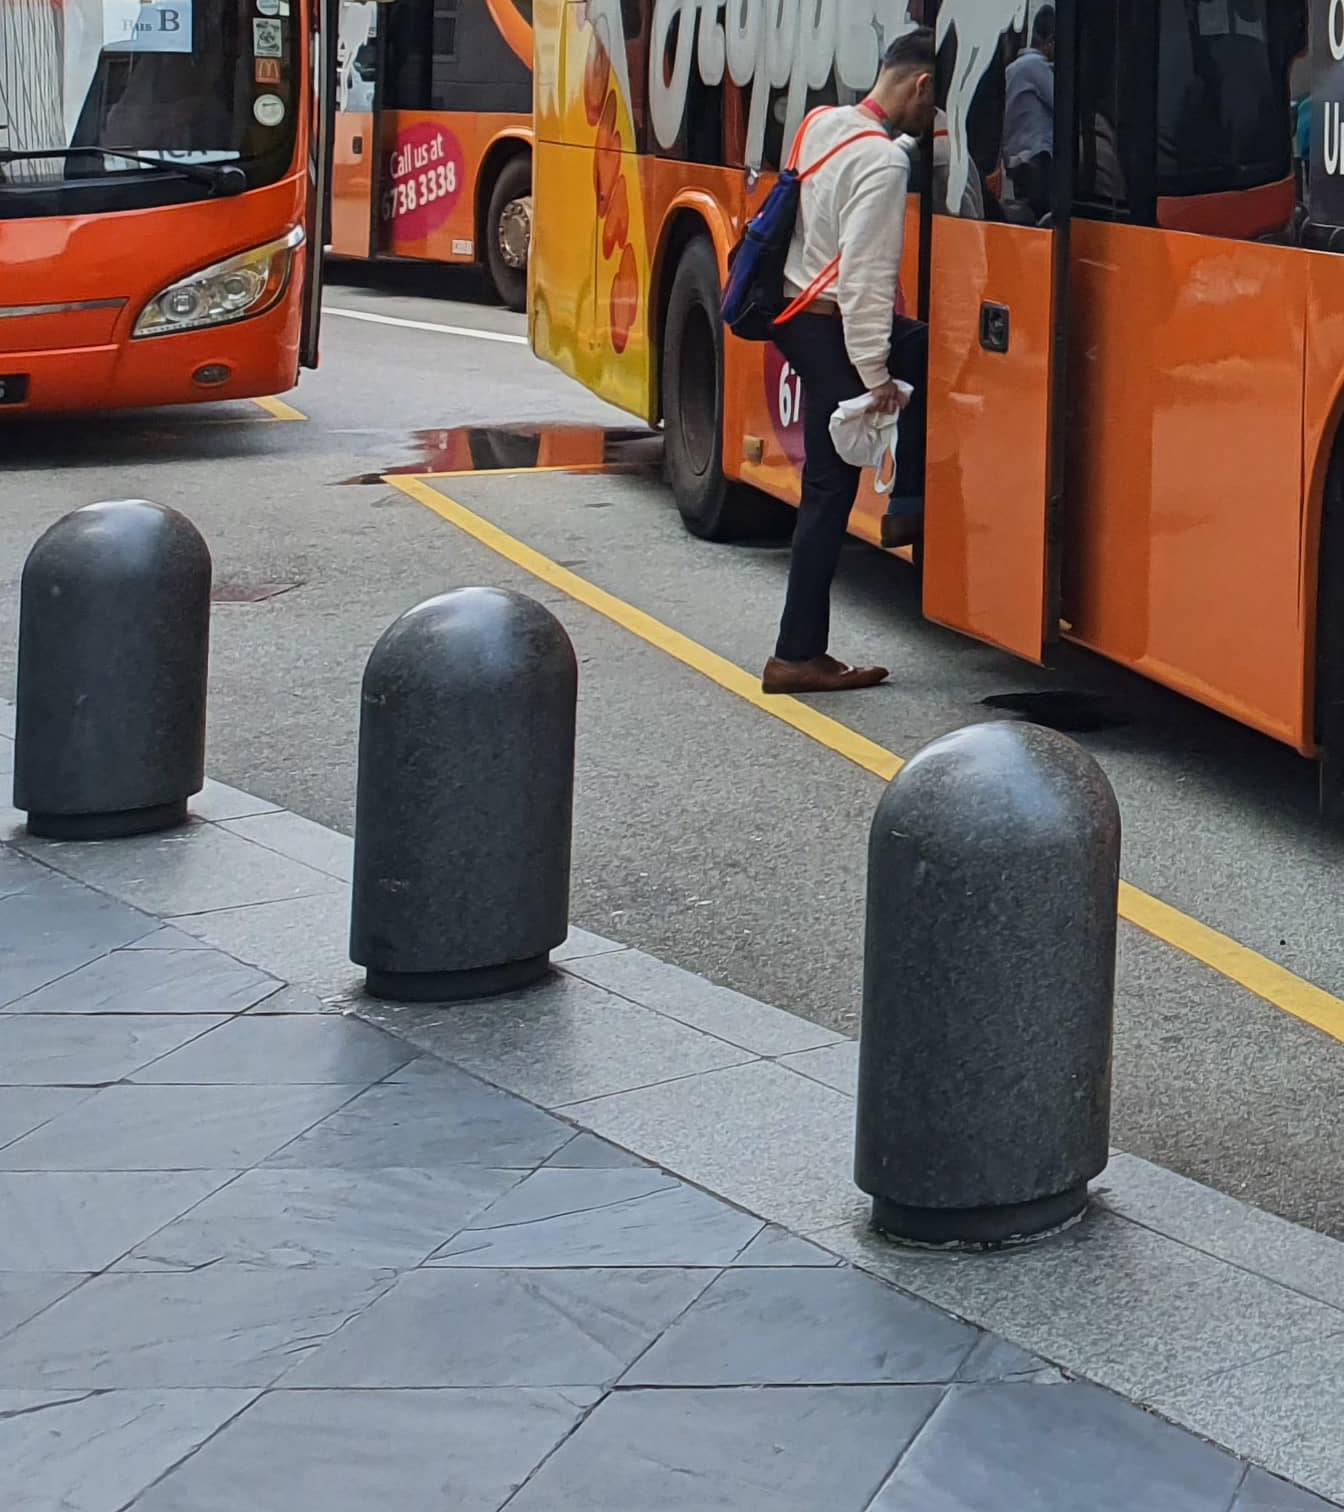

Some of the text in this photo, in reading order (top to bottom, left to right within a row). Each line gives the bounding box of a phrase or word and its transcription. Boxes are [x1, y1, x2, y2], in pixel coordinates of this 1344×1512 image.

[158, 8, 180, 32] B
[390, 132, 444, 179] Call us at
[419, 161, 457, 206] 3338
[779, 361, 801, 427] 67
